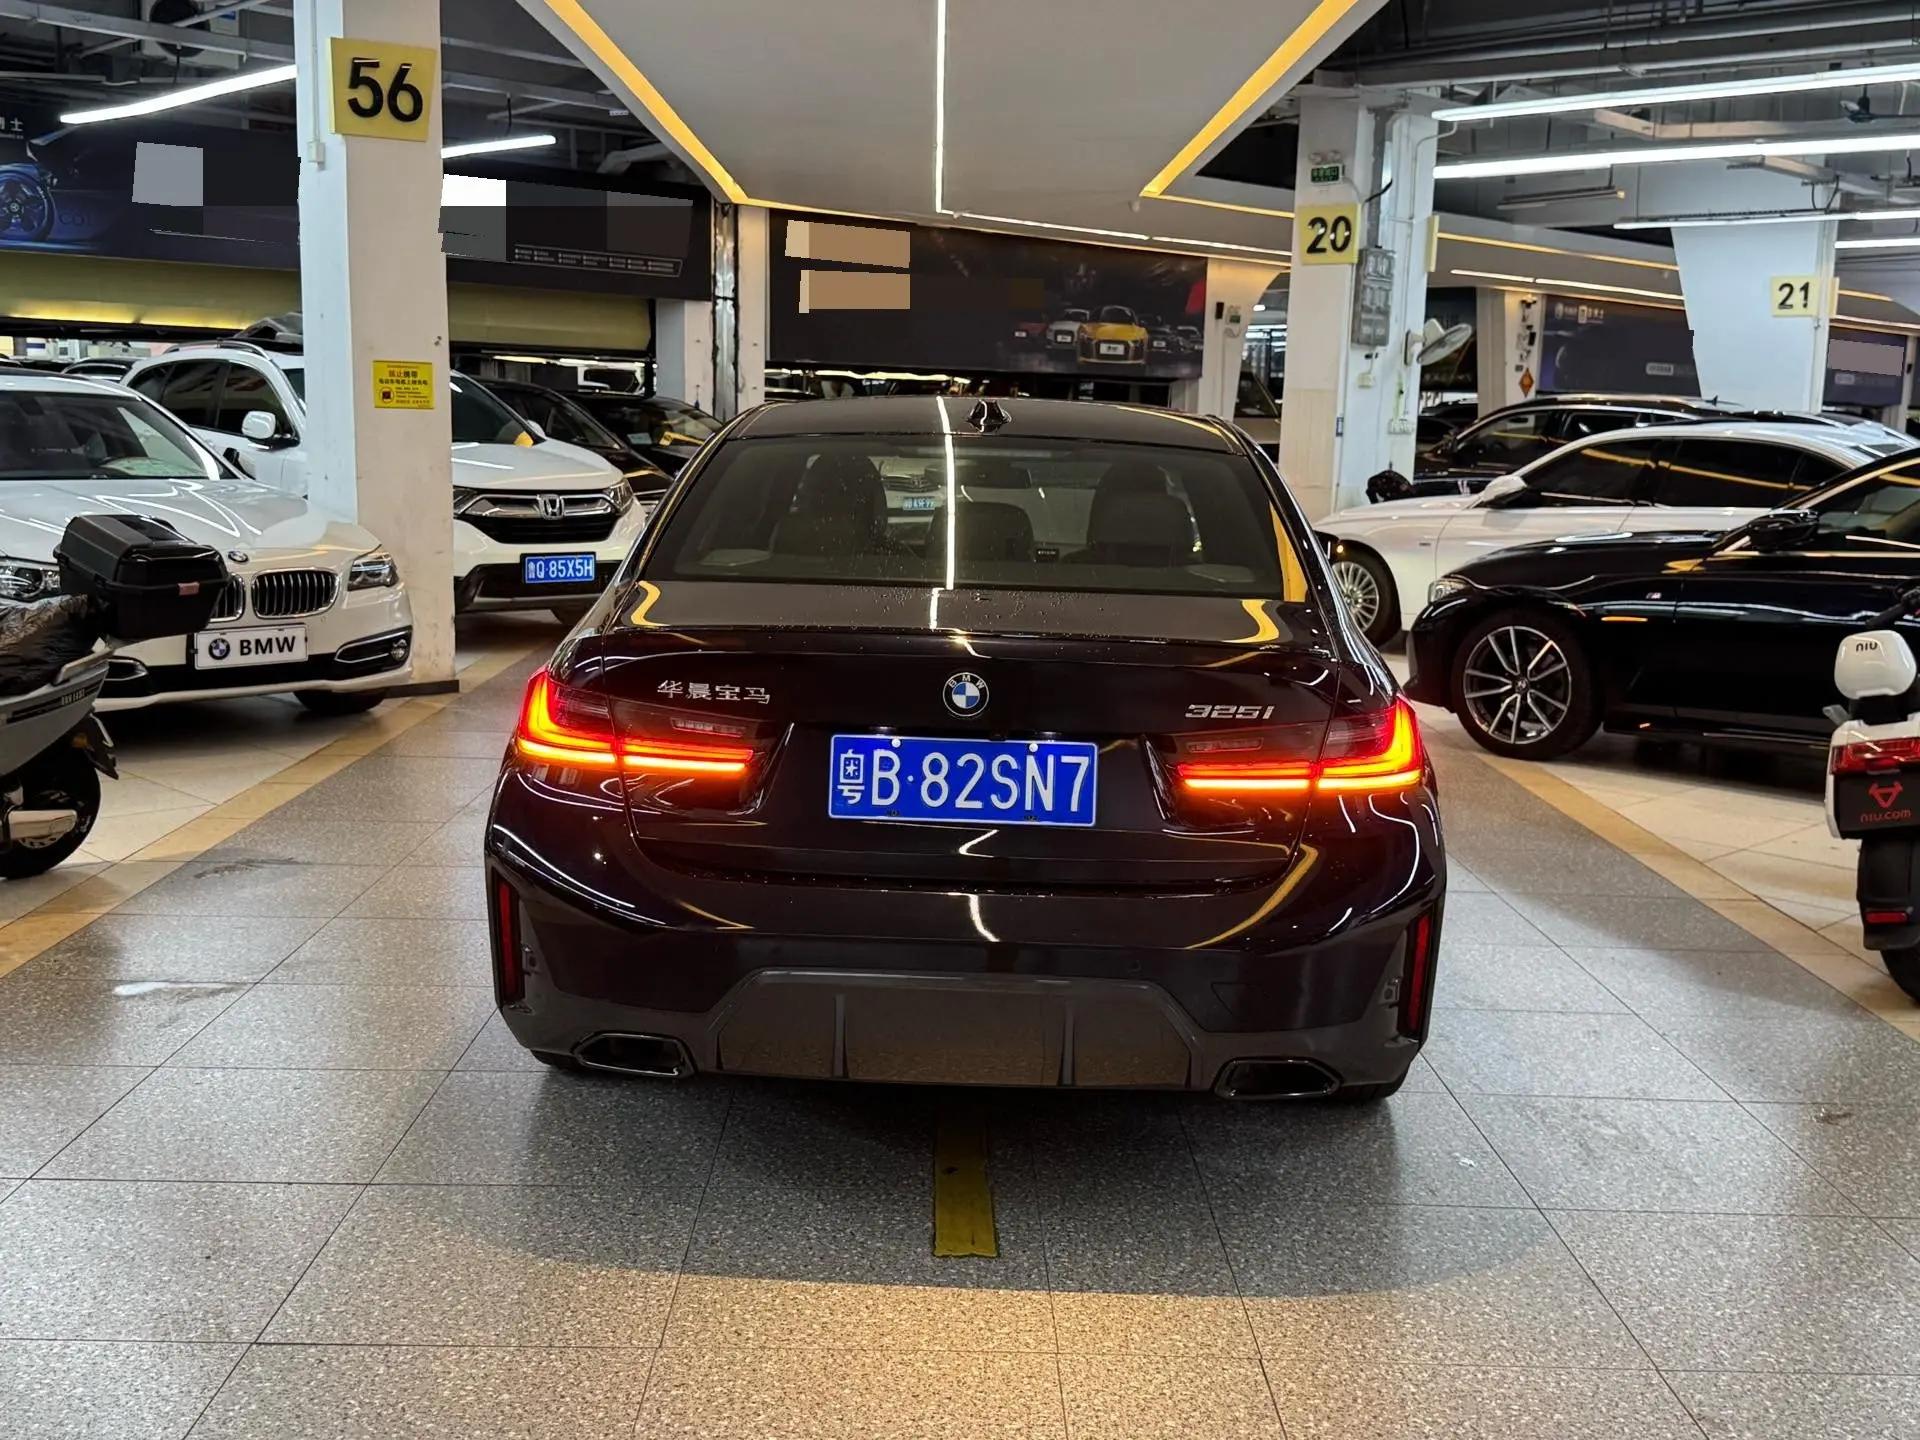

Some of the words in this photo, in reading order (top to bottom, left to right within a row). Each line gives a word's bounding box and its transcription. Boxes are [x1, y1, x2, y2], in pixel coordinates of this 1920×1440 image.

[347, 56, 424, 123] 56
[1306, 215, 1352, 254] 20
[1777, 281, 1810, 309] 21
[240, 635, 296, 657] BMW
[657, 680, 771, 705] 华晨宝马
[948, 673, 986, 689] BMW
[837, 748, 1091, 813] 粤B·82SN7
